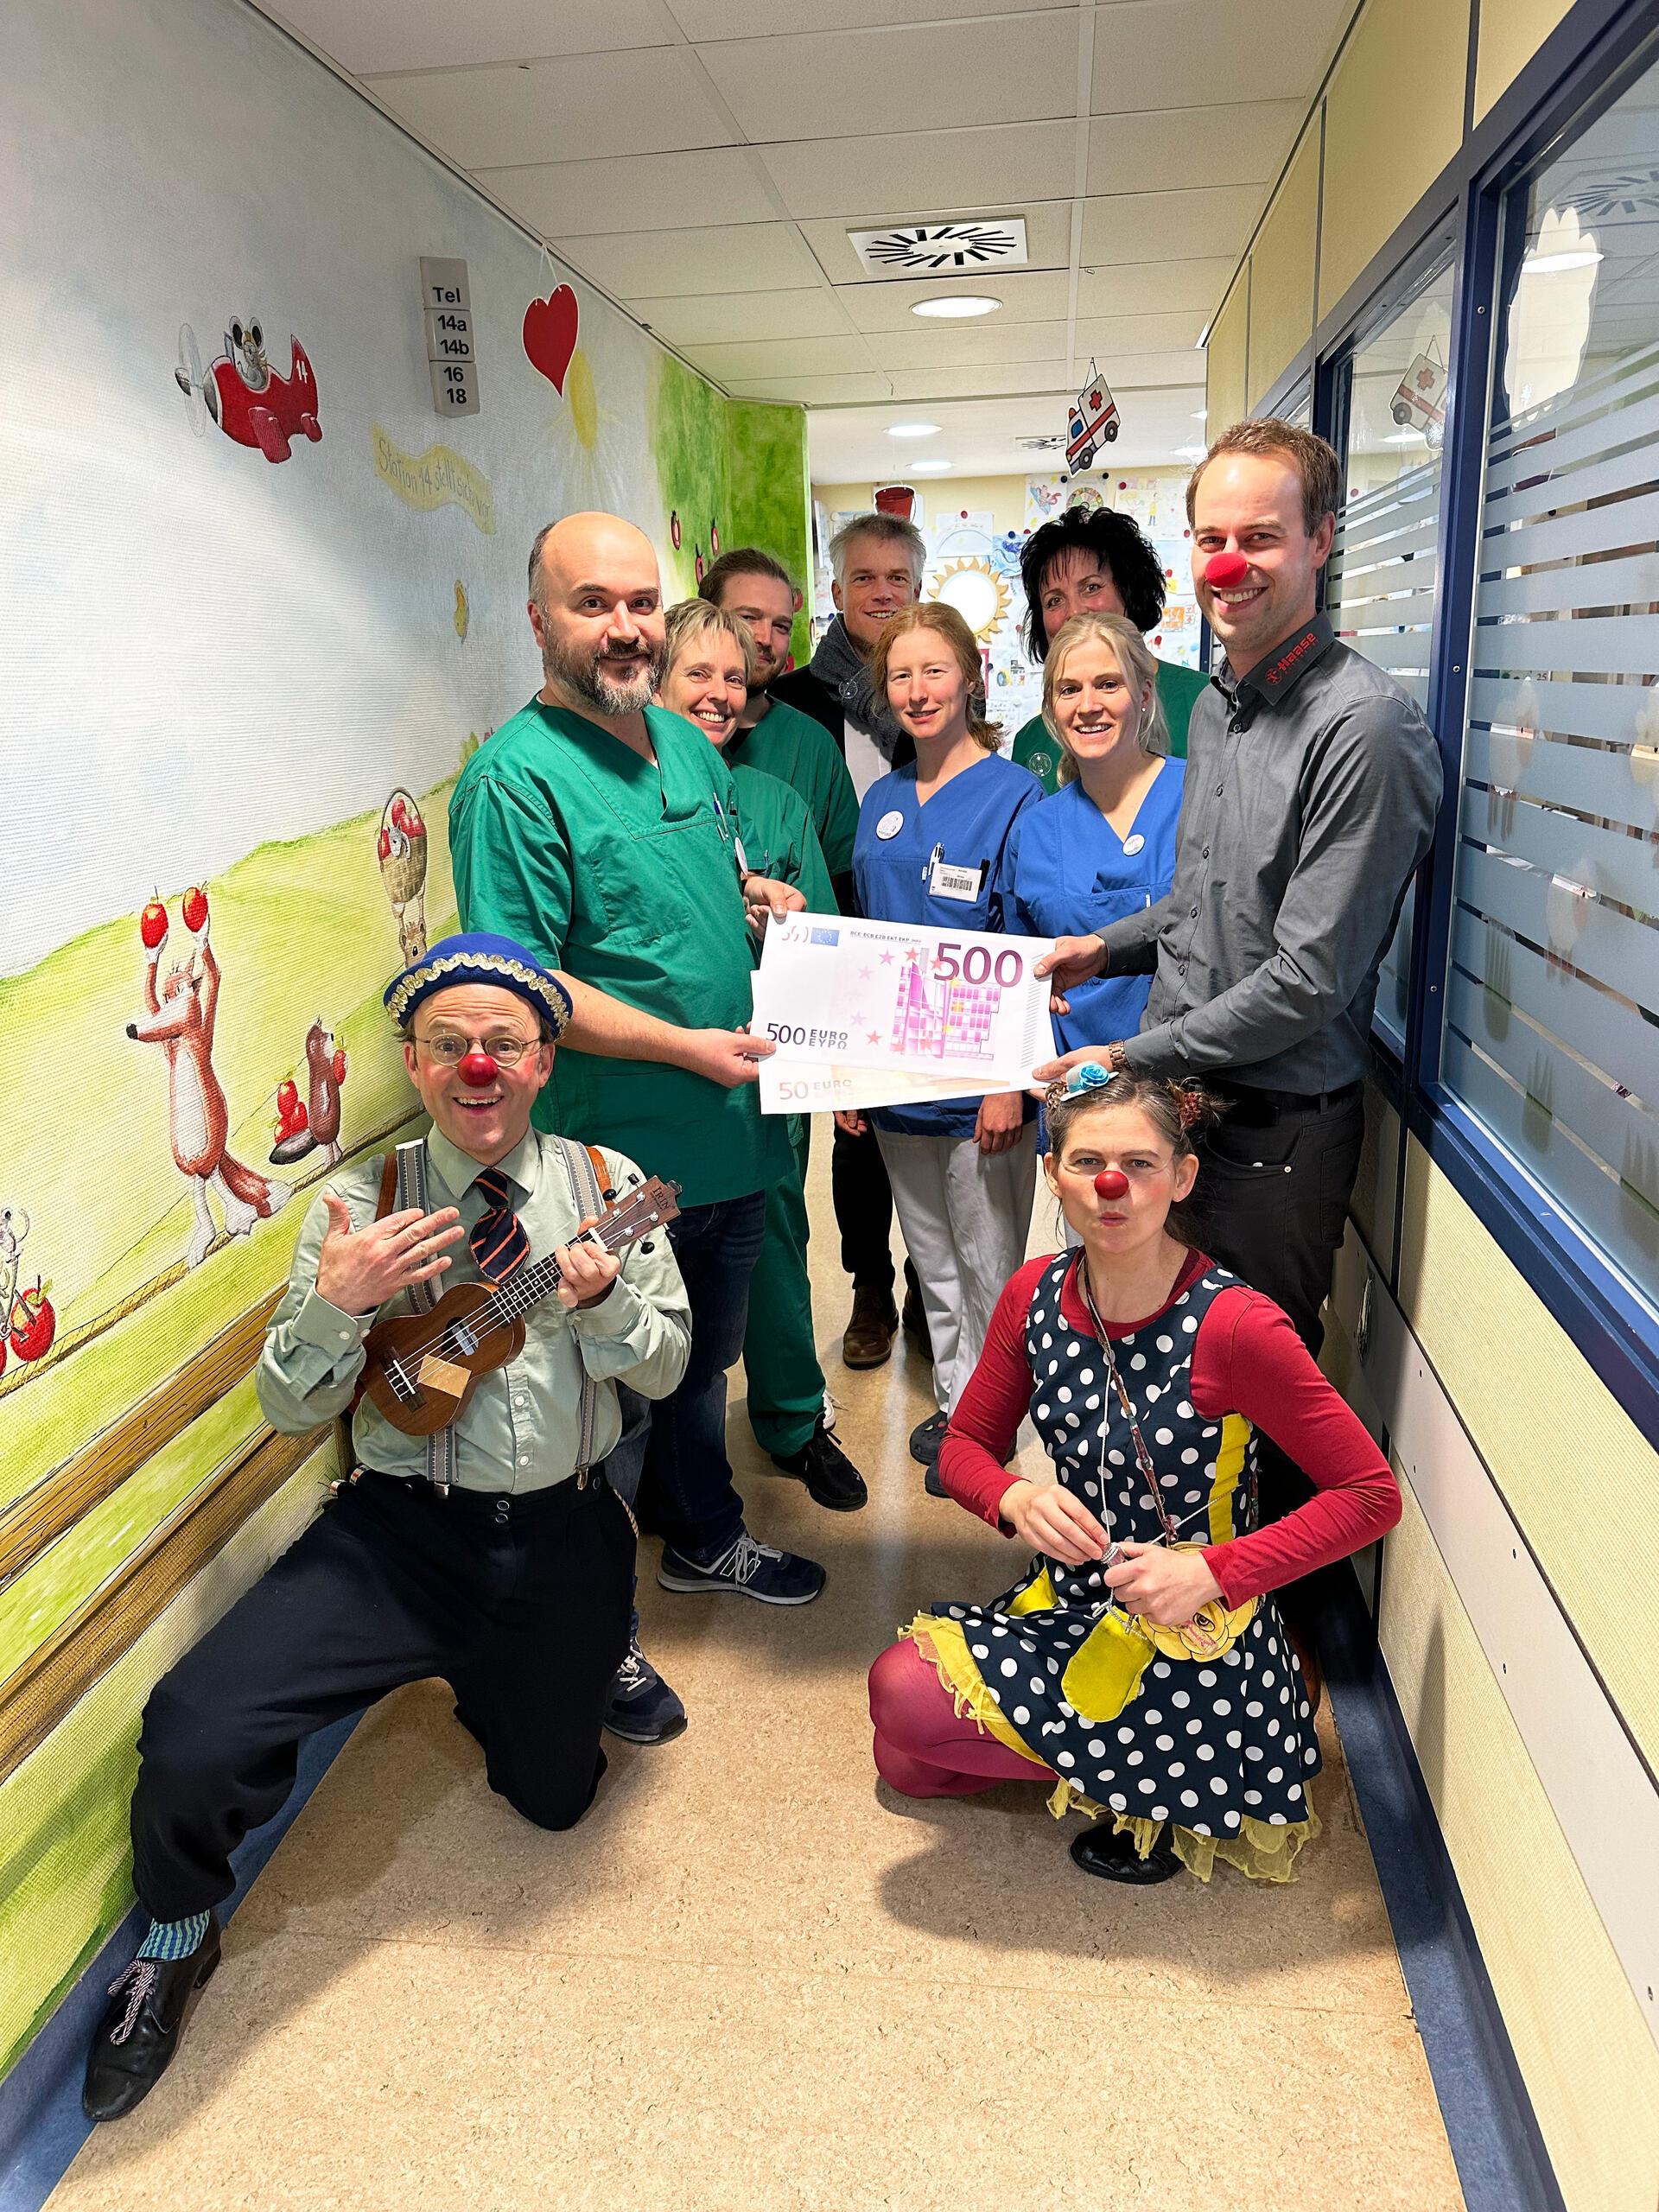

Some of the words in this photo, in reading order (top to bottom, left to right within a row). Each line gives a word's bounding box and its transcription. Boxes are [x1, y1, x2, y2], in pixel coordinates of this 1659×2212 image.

[433, 286, 461, 303] Tel
[438, 315, 467, 332] 14a
[440, 339, 469, 355] 14b
[296, 359, 308, 384] 14
[444, 366, 464, 383] 16
[447, 388, 467, 404] 18
[378, 438, 416, 492] Station
[419, 464, 432, 498] 14
[1278, 632, 1316, 671] Haase
[934, 942, 1023, 988] 500
[766, 1023, 806, 1046] 500
[810, 1029, 849, 1041] EURO
[779, 1081, 809, 1101] 50
[814, 1079, 852, 1090] EURO
